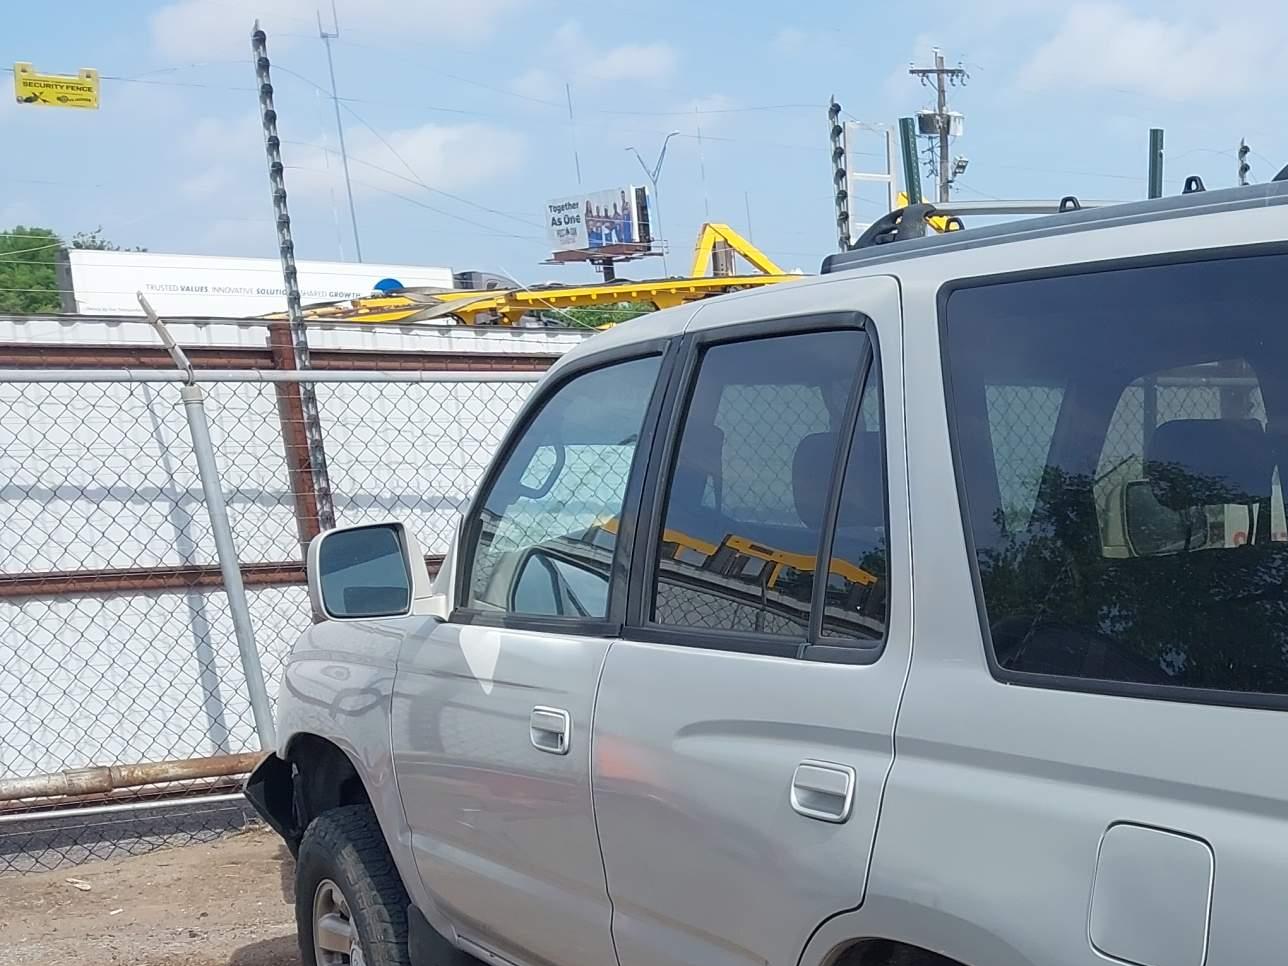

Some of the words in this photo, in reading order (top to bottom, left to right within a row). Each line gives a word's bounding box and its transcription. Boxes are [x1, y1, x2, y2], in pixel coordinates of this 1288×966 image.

[22, 81, 65, 90] SECURITY
[65, 85, 94, 93] FENCE
[548, 202, 579, 214] Together
[551, 216, 563, 227] As
[563, 214, 581, 226] One
[145, 283, 179, 292] TRUSTED
[211, 286, 255, 295] INNOVATIVE
